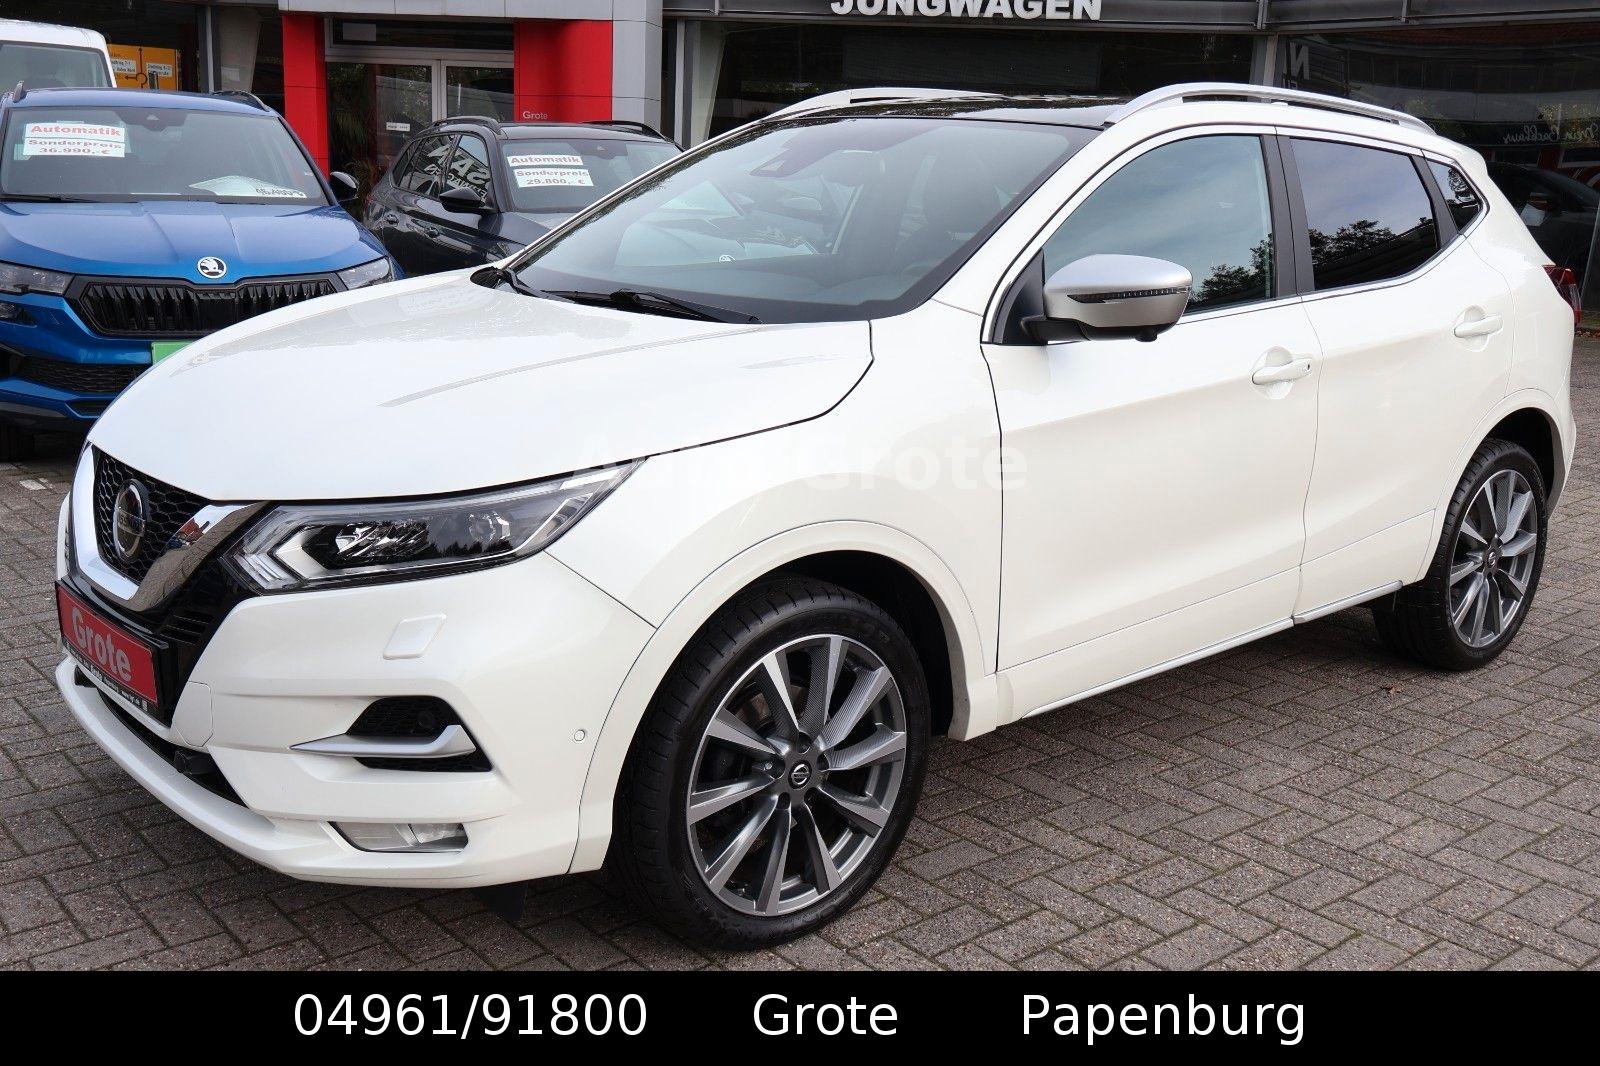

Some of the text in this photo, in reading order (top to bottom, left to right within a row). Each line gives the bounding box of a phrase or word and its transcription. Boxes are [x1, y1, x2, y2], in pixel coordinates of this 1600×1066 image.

[831, 0, 1103, 20] JUNGWAGEN
[522, 110, 549, 120] Grote
[30, 124, 122, 137] Automatik
[28, 139, 122, 150] Sonderpreis
[511, 155, 581, 165] Automatik
[516, 169, 589, 178] Sonderpreis
[71, 606, 132, 683] Grote
